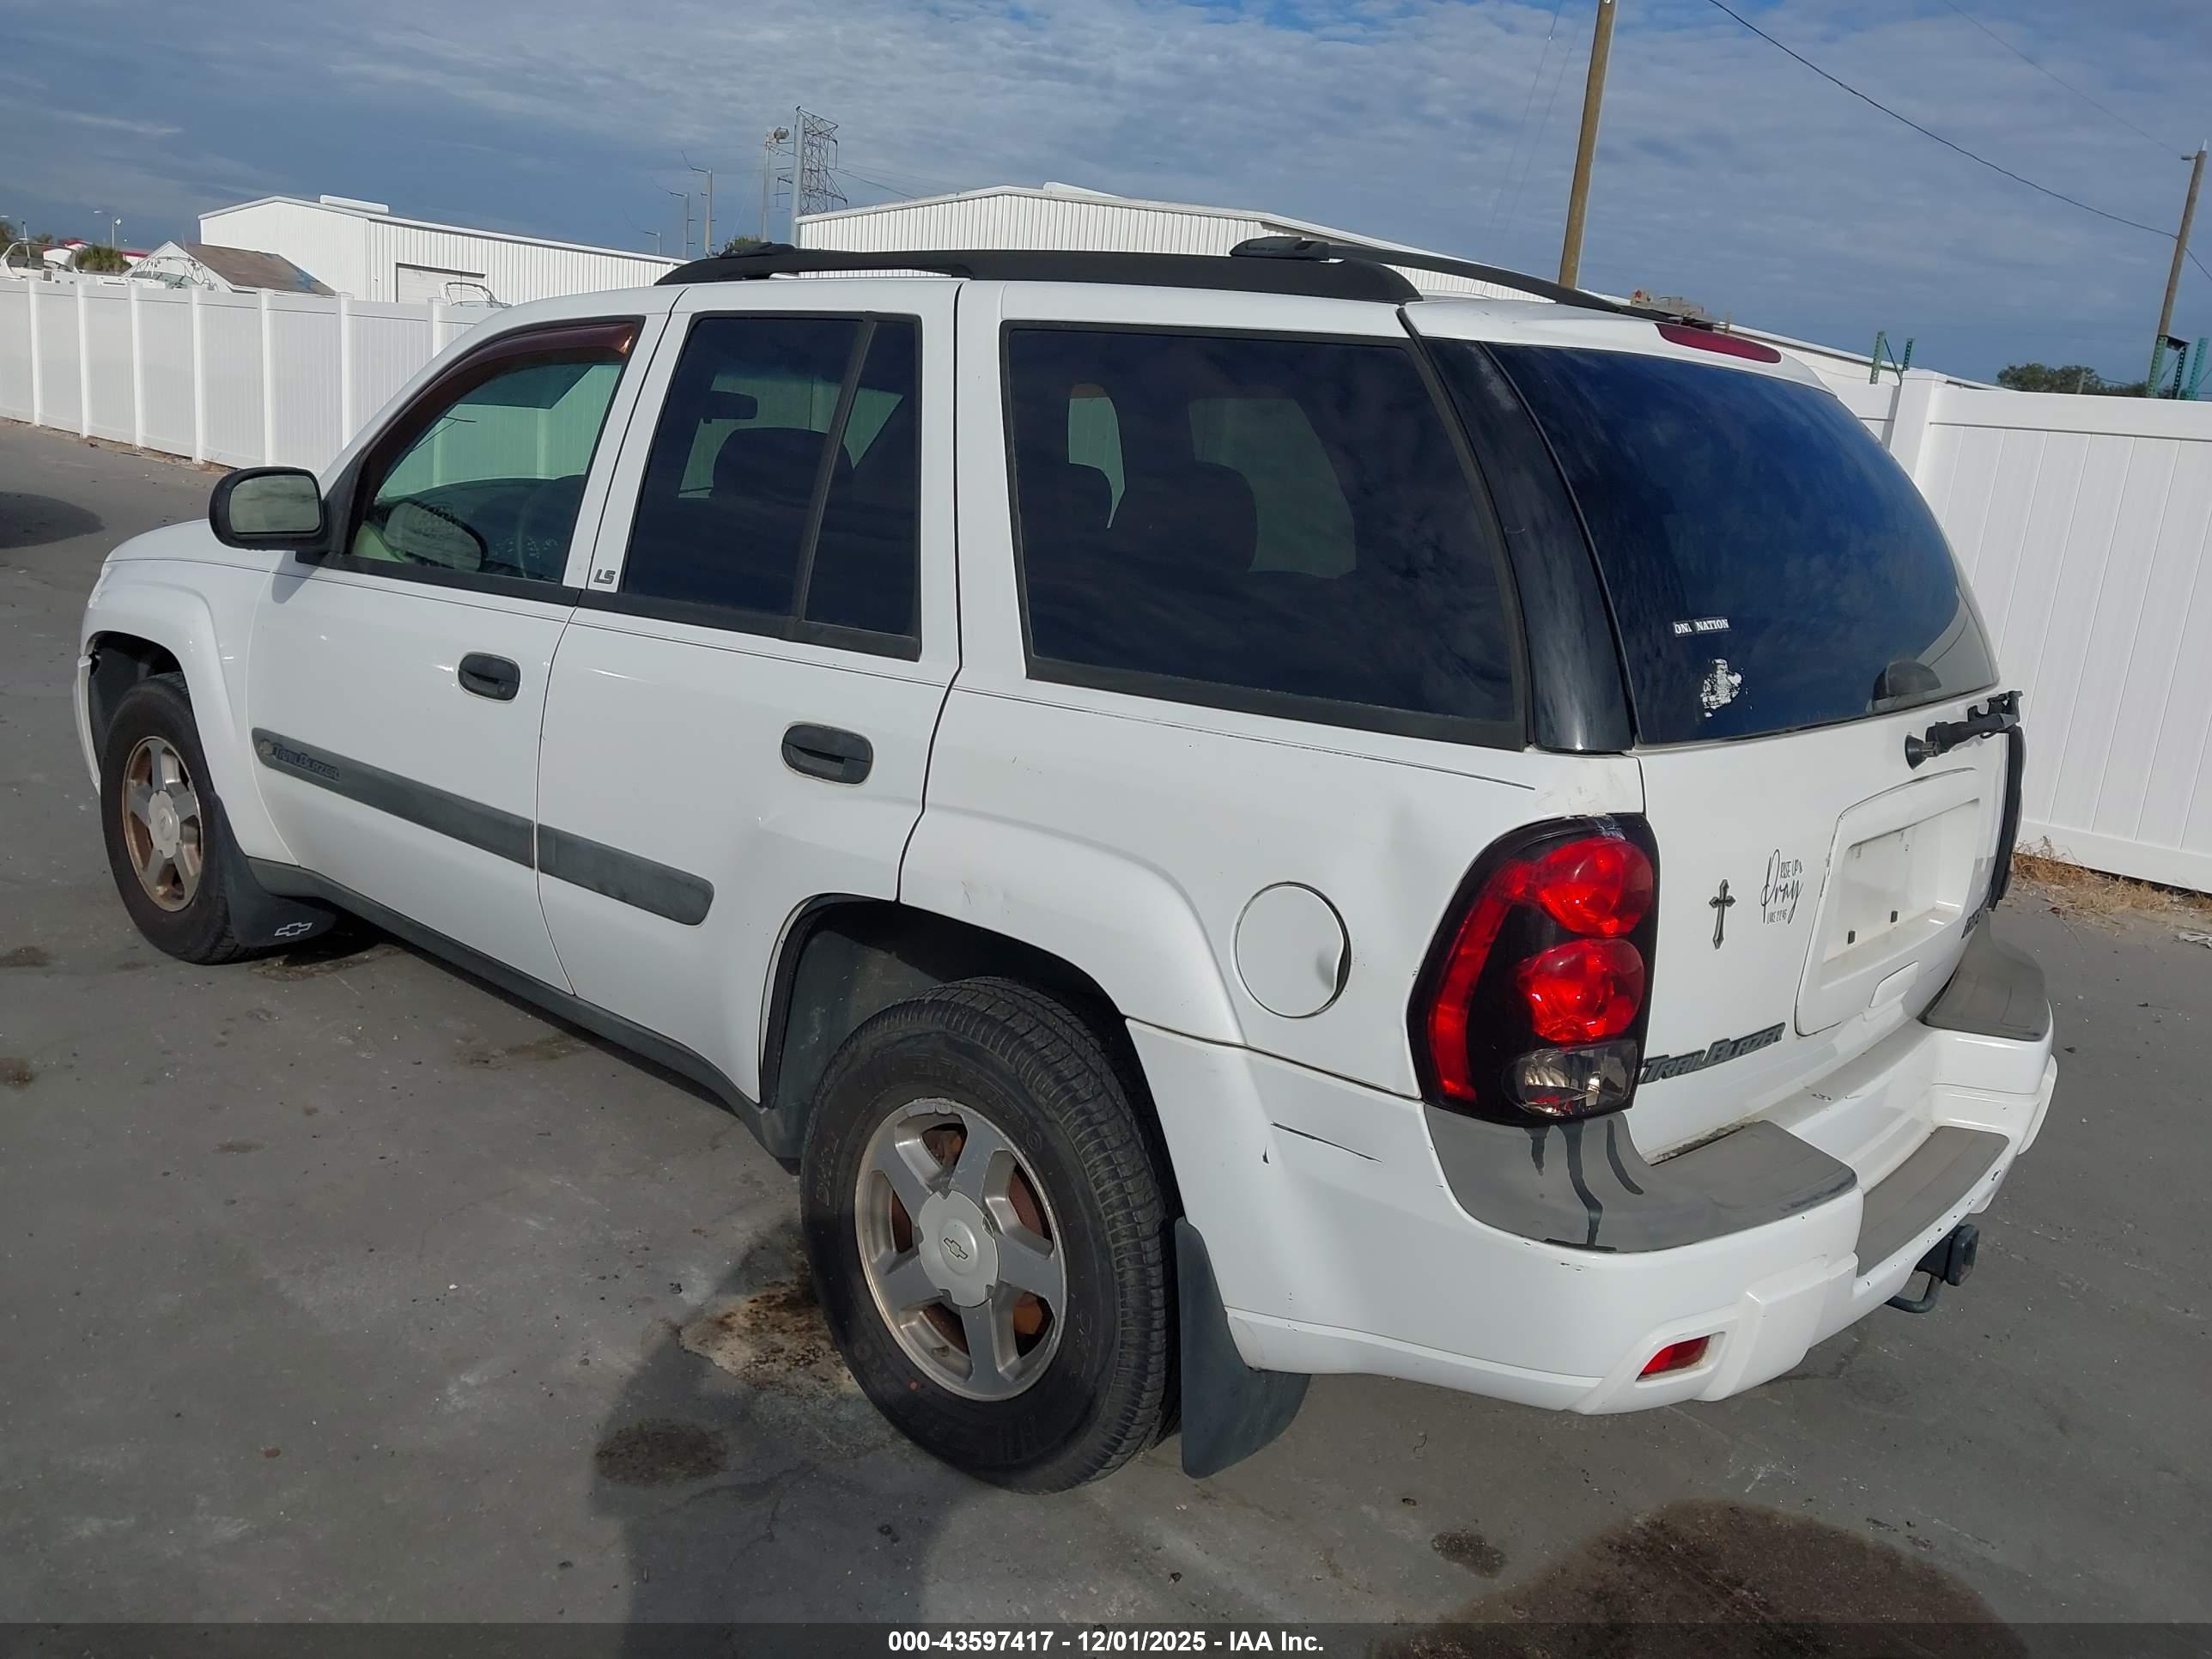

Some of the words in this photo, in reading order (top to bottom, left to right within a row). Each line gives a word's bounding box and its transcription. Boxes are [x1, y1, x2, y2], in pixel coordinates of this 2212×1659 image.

[593, 568, 617, 585] LS
[1694, 618, 1730, 631] NATION
[1760, 848, 1804, 925] Pray
